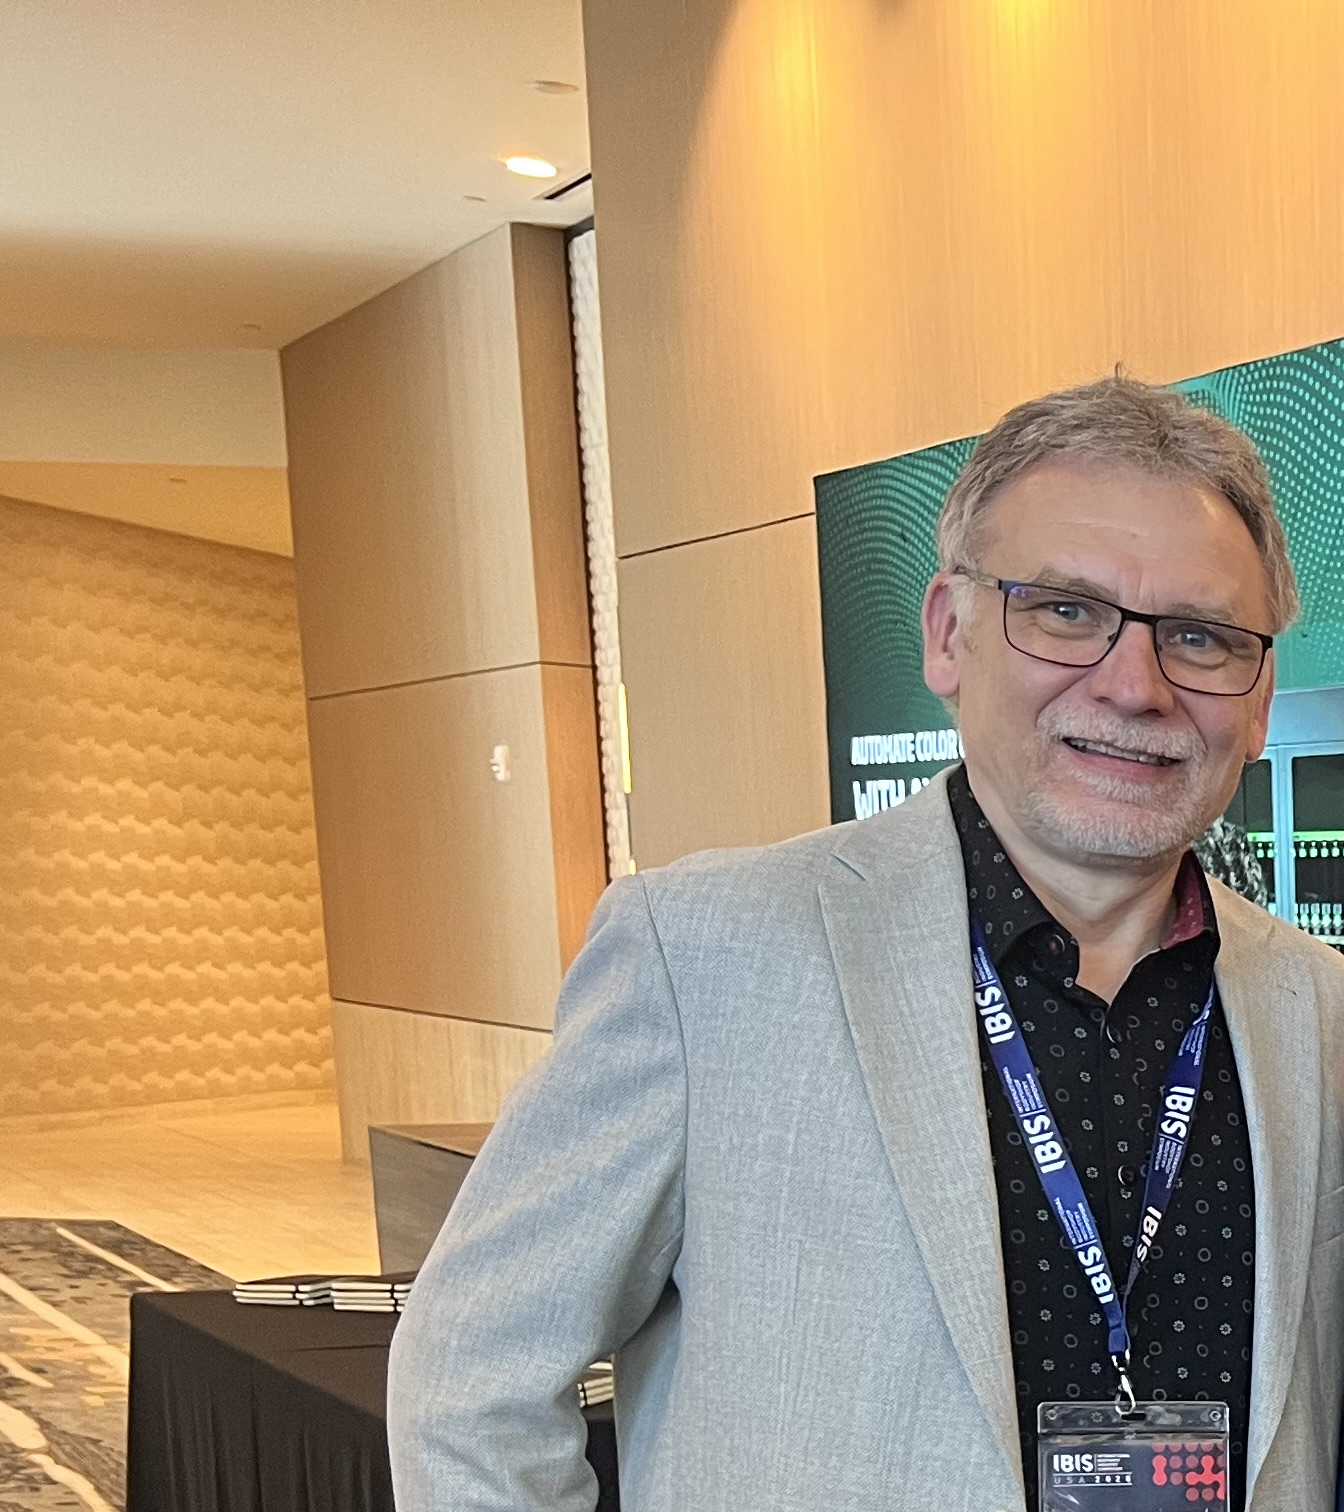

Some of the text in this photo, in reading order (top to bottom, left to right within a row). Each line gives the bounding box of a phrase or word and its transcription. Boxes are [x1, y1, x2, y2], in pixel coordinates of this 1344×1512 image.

[851, 732, 916, 766] AUTOMATE
[915, 729, 959, 762] COLOR
[974, 986, 1016, 1045] IBIS
[1160, 1086, 1196, 1138] IBIS
[1022, 1114, 1067, 1175] IBIS
[1136, 1206, 1162, 1262] IBIS
[1077, 1245, 1115, 1304] IBIS
[1053, 1453, 1094, 1473] IBIS
[1053, 1476, 1086, 1485] USA
